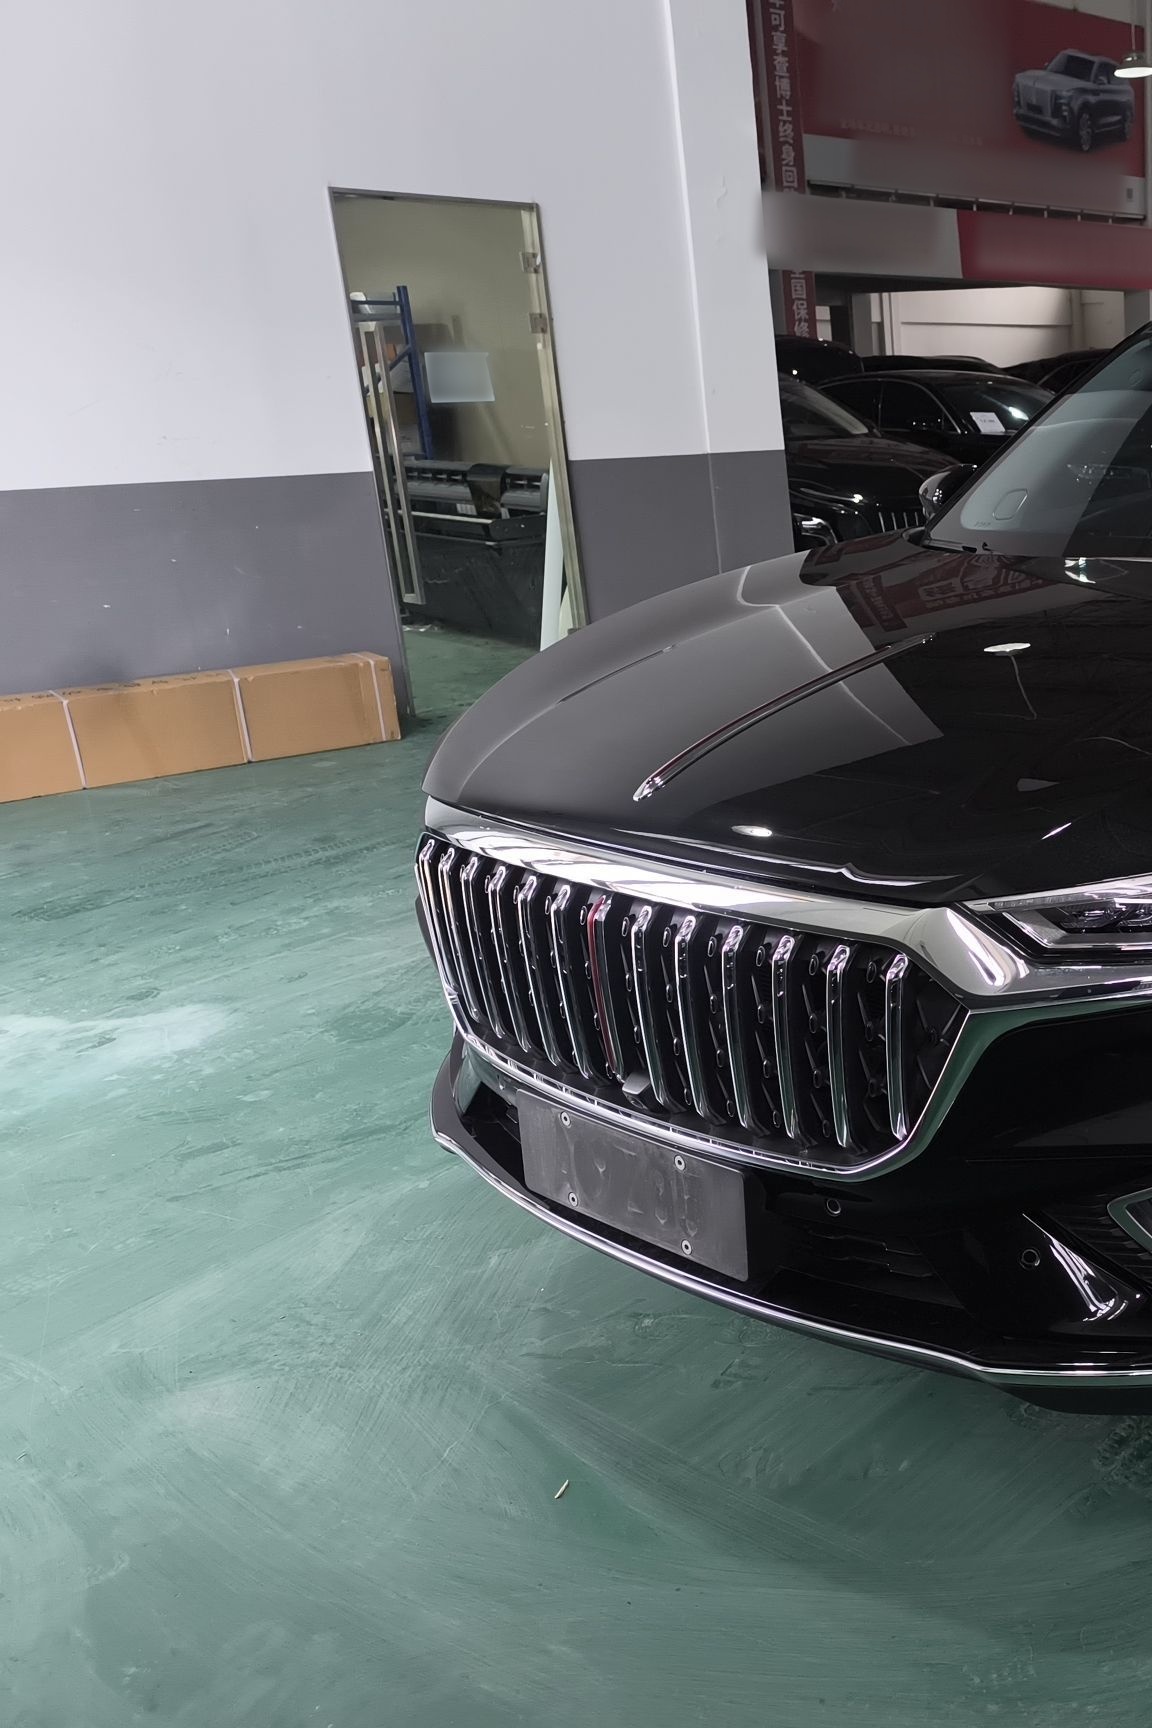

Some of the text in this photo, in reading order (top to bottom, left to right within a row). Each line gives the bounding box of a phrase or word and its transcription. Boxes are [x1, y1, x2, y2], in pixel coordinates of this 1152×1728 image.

[769, 0, 798, 192] 可享查博士终身回
